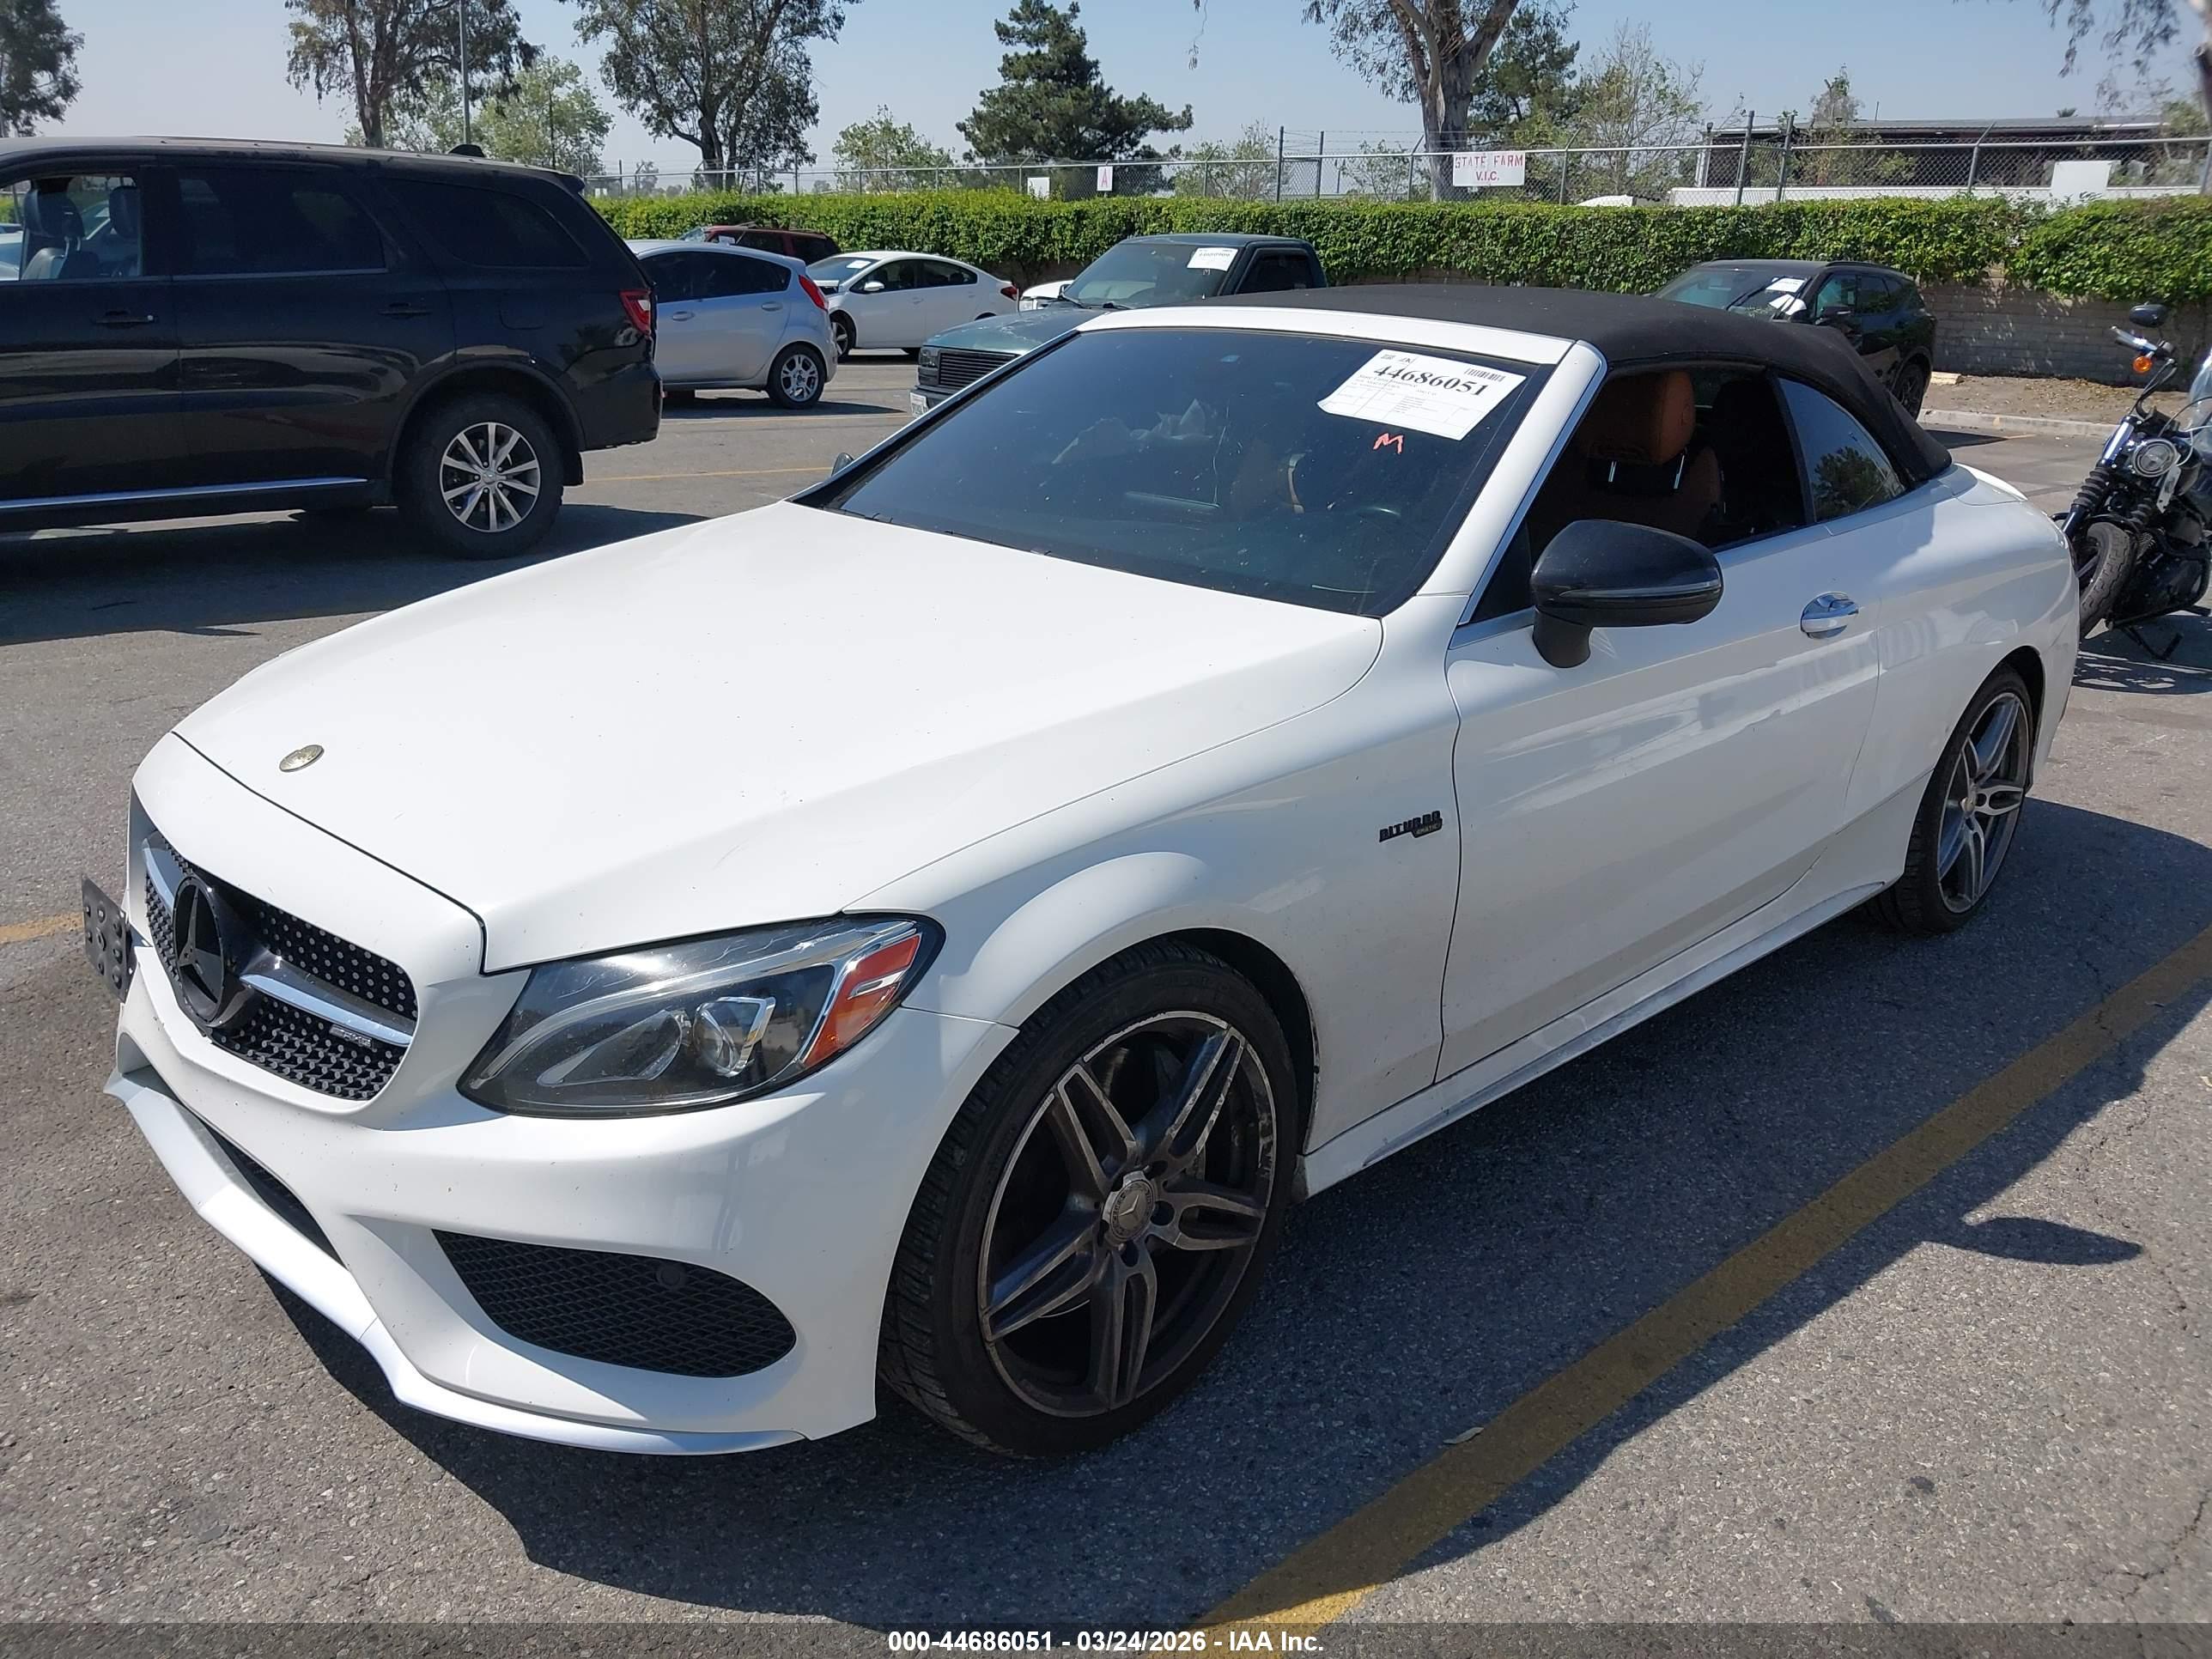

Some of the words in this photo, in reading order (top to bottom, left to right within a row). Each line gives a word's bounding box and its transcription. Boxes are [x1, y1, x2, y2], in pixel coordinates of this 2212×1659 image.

[1455, 155, 1486, 168] STATE
[1494, 155, 1523, 167] FARM
[1101, 167, 1108, 188] A
[1475, 171, 1499, 181] V.I.C.
[1373, 365, 1489, 397] 44686051
[1373, 433, 1404, 454] M
